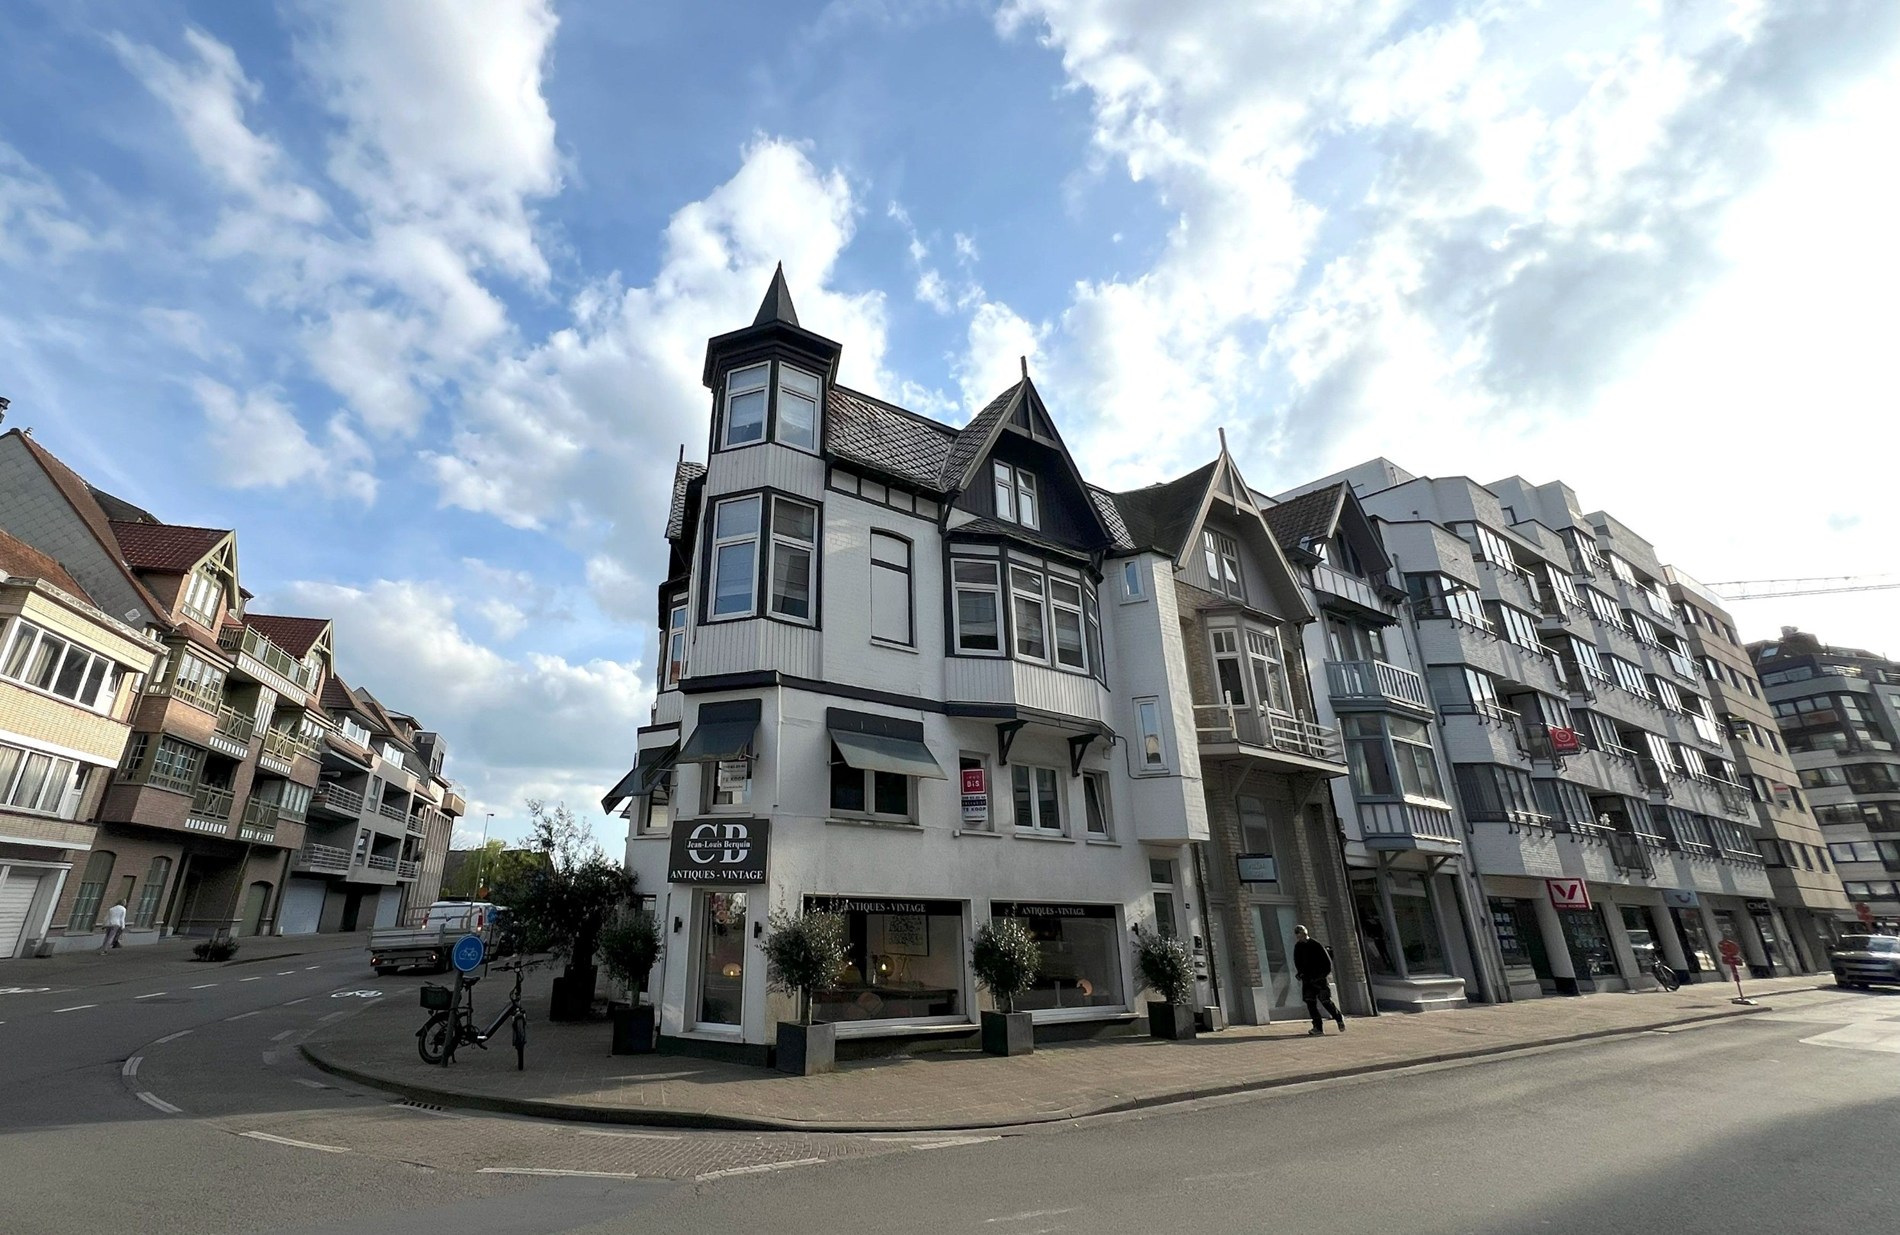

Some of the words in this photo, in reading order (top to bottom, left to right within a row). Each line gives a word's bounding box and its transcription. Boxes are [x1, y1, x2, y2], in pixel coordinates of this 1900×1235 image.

[724, 841, 751, 850] Berquin
[670, 870, 715, 880] ANTIQUES
[722, 870, 763, 879] VINTAGE
[891, 903, 926, 912] VINTAGE
[1022, 906, 1054, 916] ANTIQUES
[1058, 907, 1085, 915] VINTAGE
